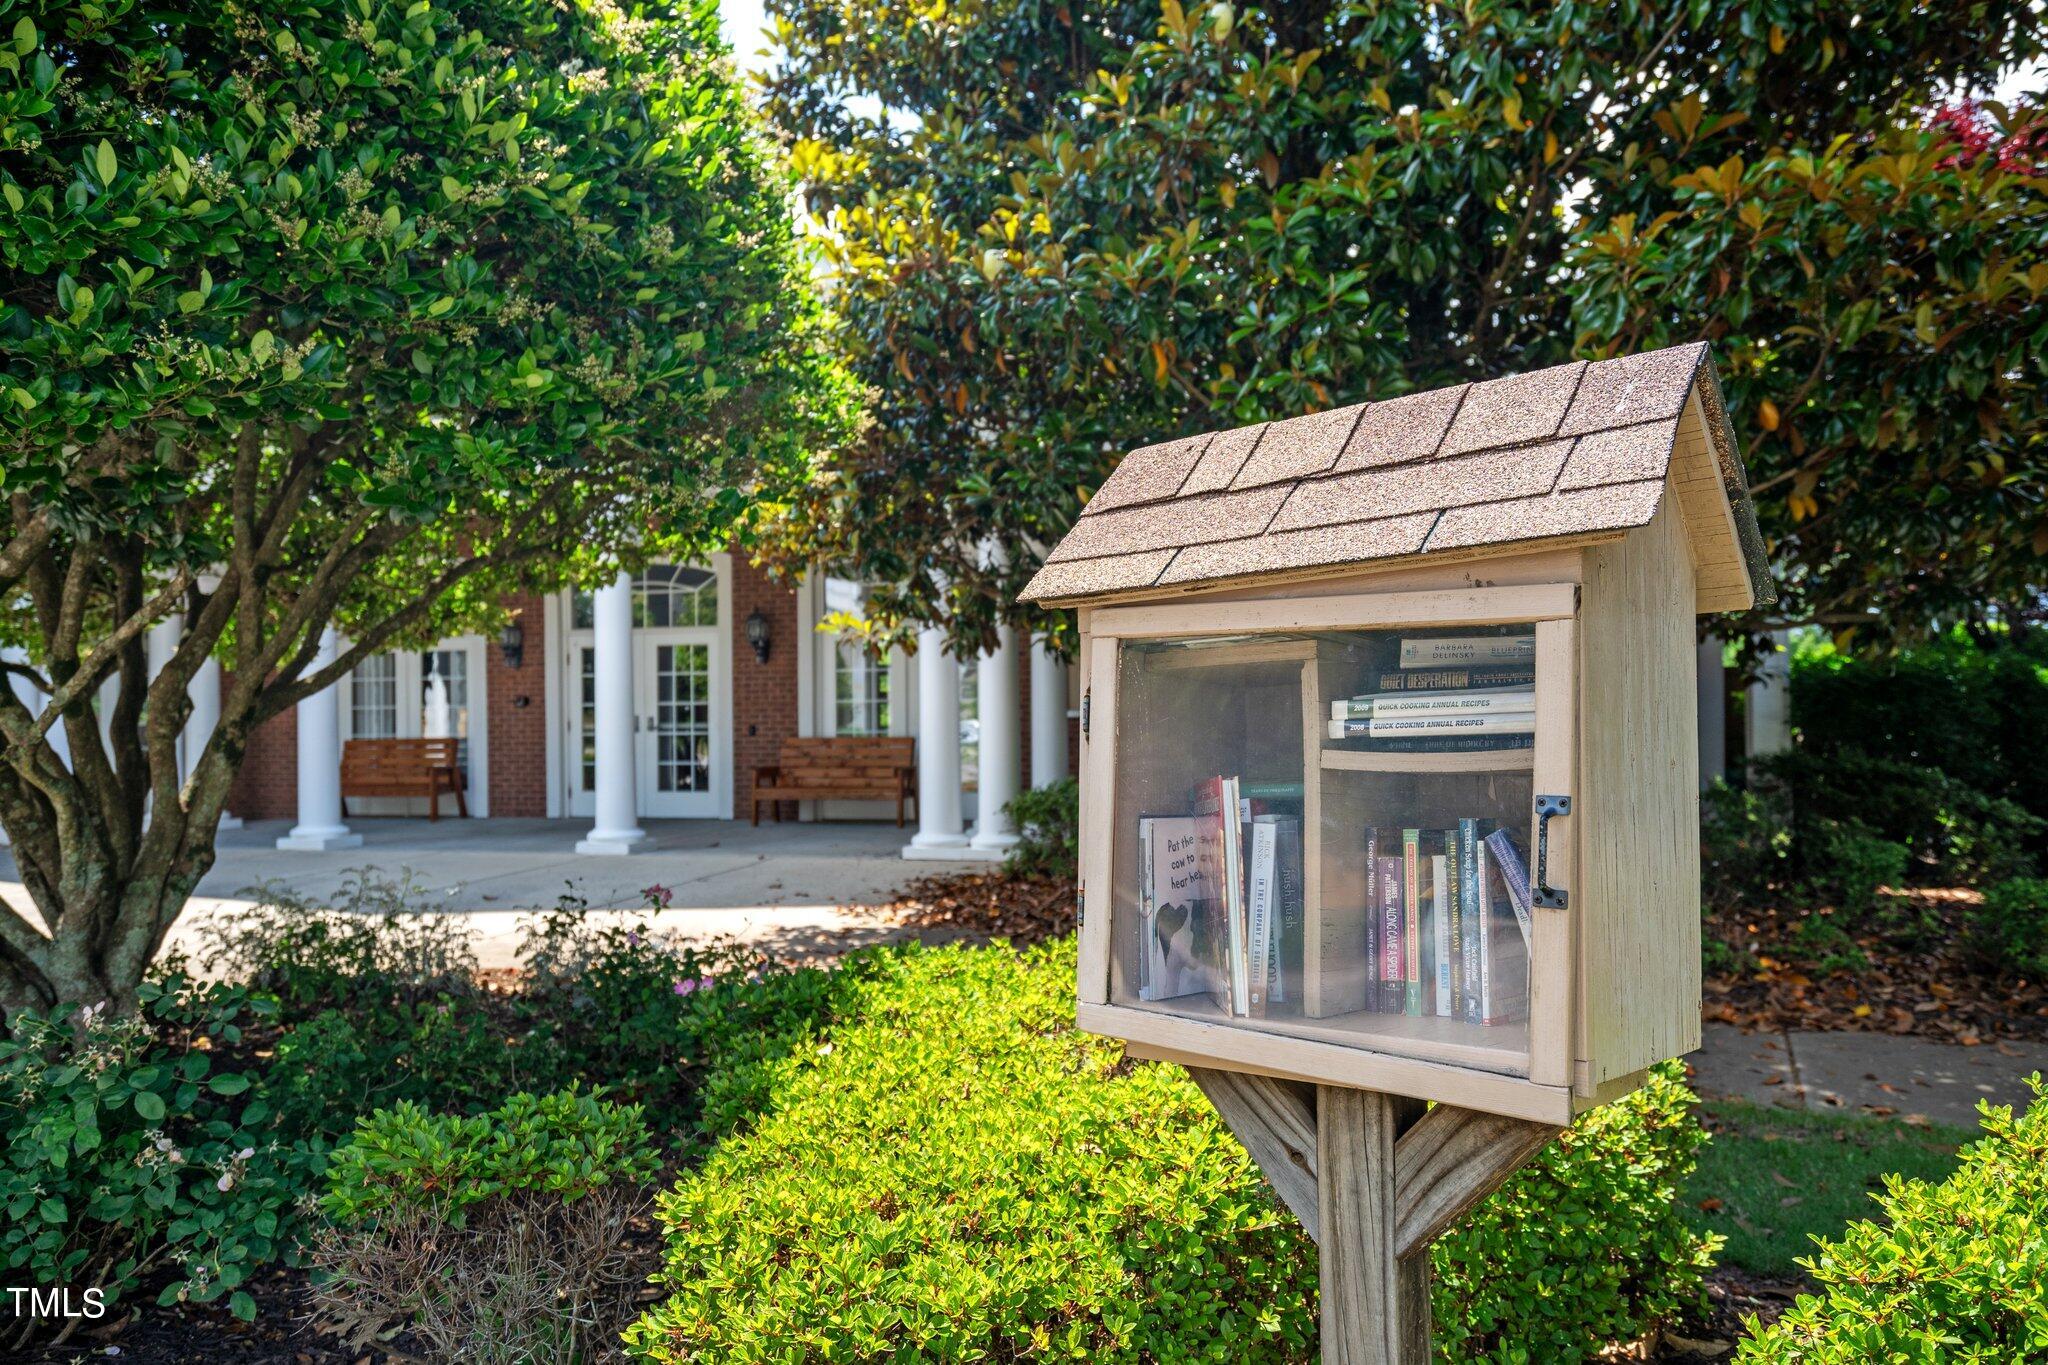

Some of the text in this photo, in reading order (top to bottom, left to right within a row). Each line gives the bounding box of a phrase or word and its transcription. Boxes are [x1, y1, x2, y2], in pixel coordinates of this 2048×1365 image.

[1380, 671, 1469, 689] QUIET DESPERATION
[1461, 699, 1491, 707] RECIPES
[1374, 719, 1484, 730] QUICK COOKING ANNUAL RECIPES
[1181, 835, 1194, 848] the
[1256, 829, 1265, 870] ATKINSON
[1263, 840, 1272, 859] RICK
[1171, 853, 1195, 870] cow to
[1366, 840, 1375, 870] George
[1463, 828, 1474, 905] Chicken Soup for the Soul
[1171, 876, 1188, 889] hear
[1258, 878, 1265, 886] IN
[1384, 873, 1392, 905] PATTERSON
[1284, 901, 1298, 928] hush
[1386, 906, 1397, 929] ALONG
[1451, 896, 1459, 929] SANDRA
[1255, 939, 1261, 947] OF
[1386, 930, 1397, 949] CAME
[1452, 930, 1460, 953] LOVE
[1470, 946, 1478, 958] Jack
[1252, 951, 1261, 984] SOLDIERS
[1386, 956, 1398, 979] SPIDER
